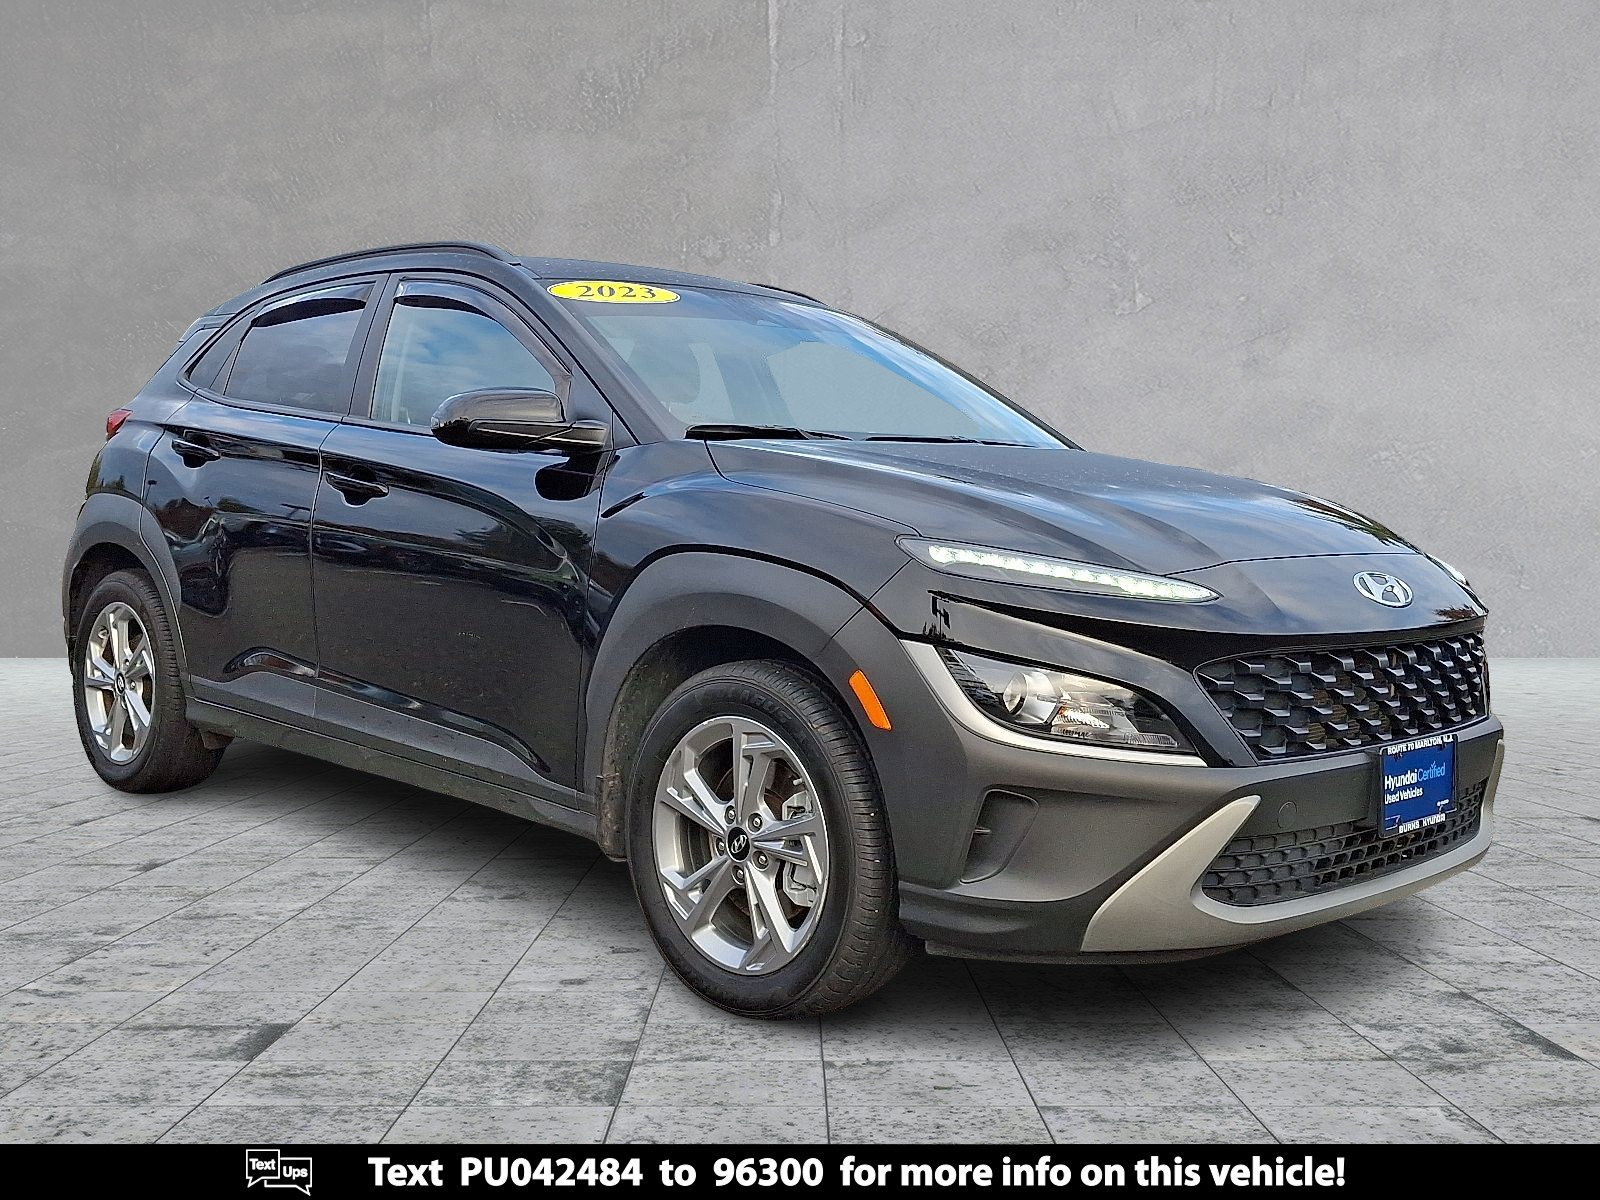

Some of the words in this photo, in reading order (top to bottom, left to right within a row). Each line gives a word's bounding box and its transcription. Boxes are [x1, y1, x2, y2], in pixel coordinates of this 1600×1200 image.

[575, 285, 657, 299] 2023
[1387, 744, 1408, 756] ROUTE
[1384, 768, 1418, 791] Hyundai
[1417, 761, 1446, 782] Certified
[1384, 791, 1400, 805] Used
[1400, 786, 1424, 802] Vehicles
[1398, 819, 1420, 834] BURNS
